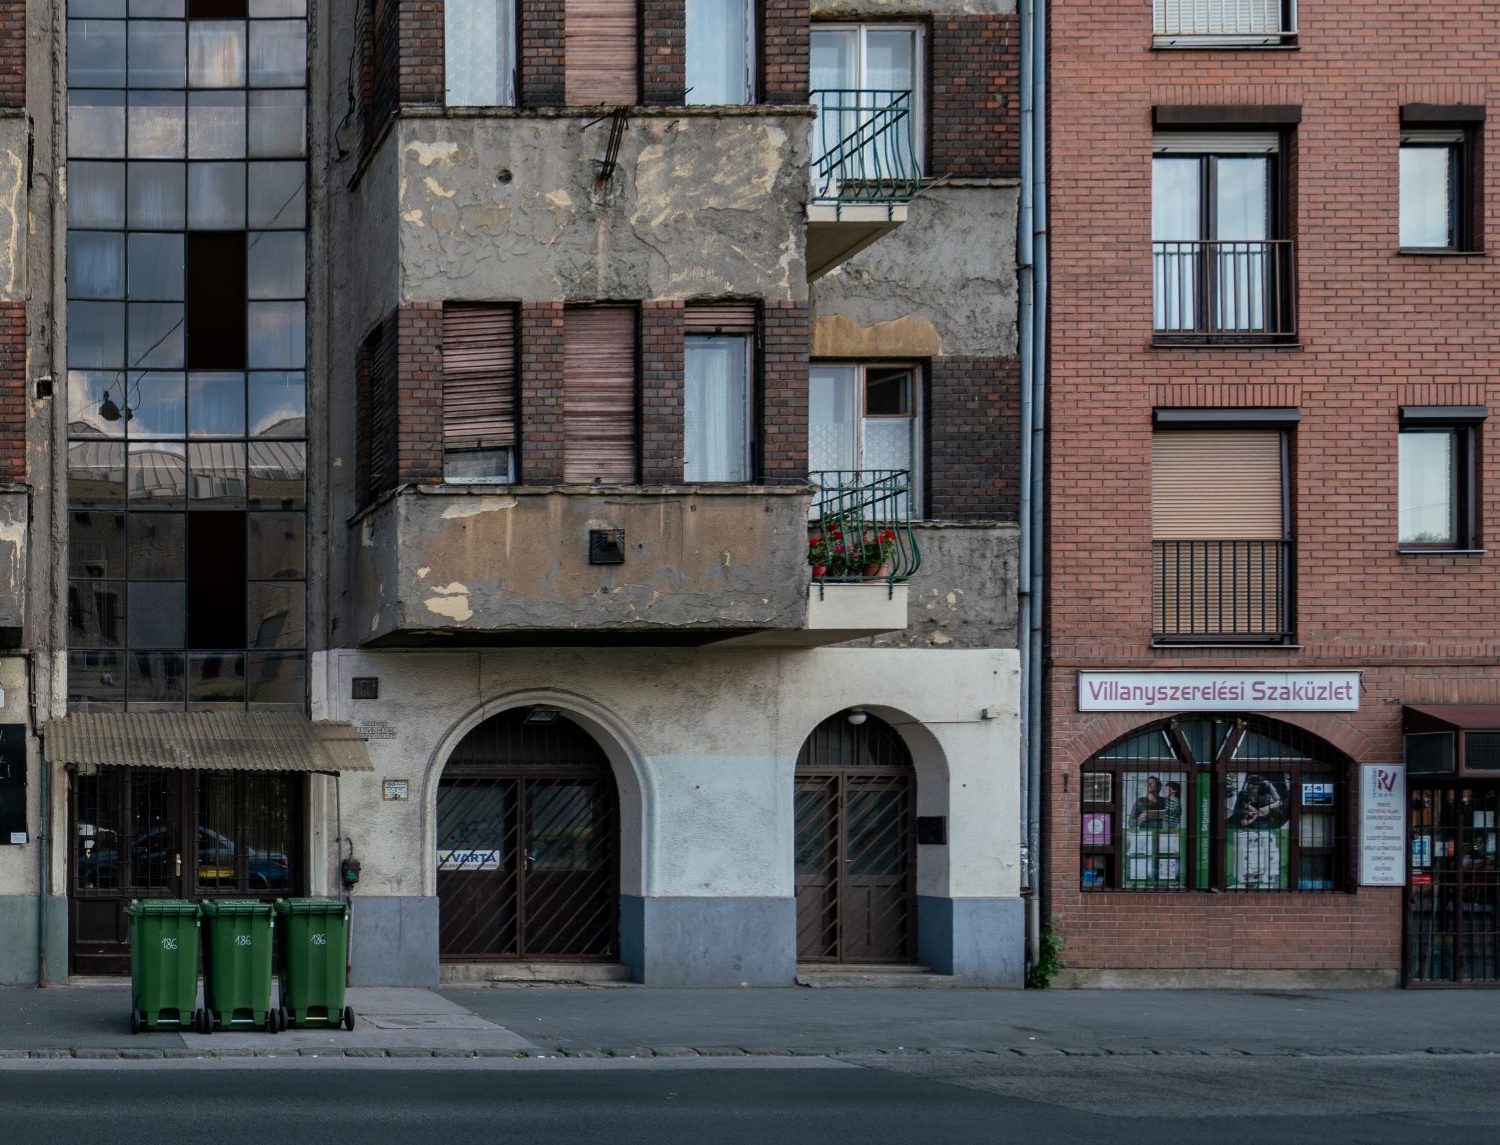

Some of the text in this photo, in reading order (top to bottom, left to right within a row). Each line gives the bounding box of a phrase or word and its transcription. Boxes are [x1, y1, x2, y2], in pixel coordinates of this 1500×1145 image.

[1088, 680, 1353, 706] Villanyszerelési Szaküzlet
[452, 853, 497, 863] VARTA
[161, 937, 178, 950] 186
[234, 935, 251, 947] 186
[311, 933, 326, 945] 186
